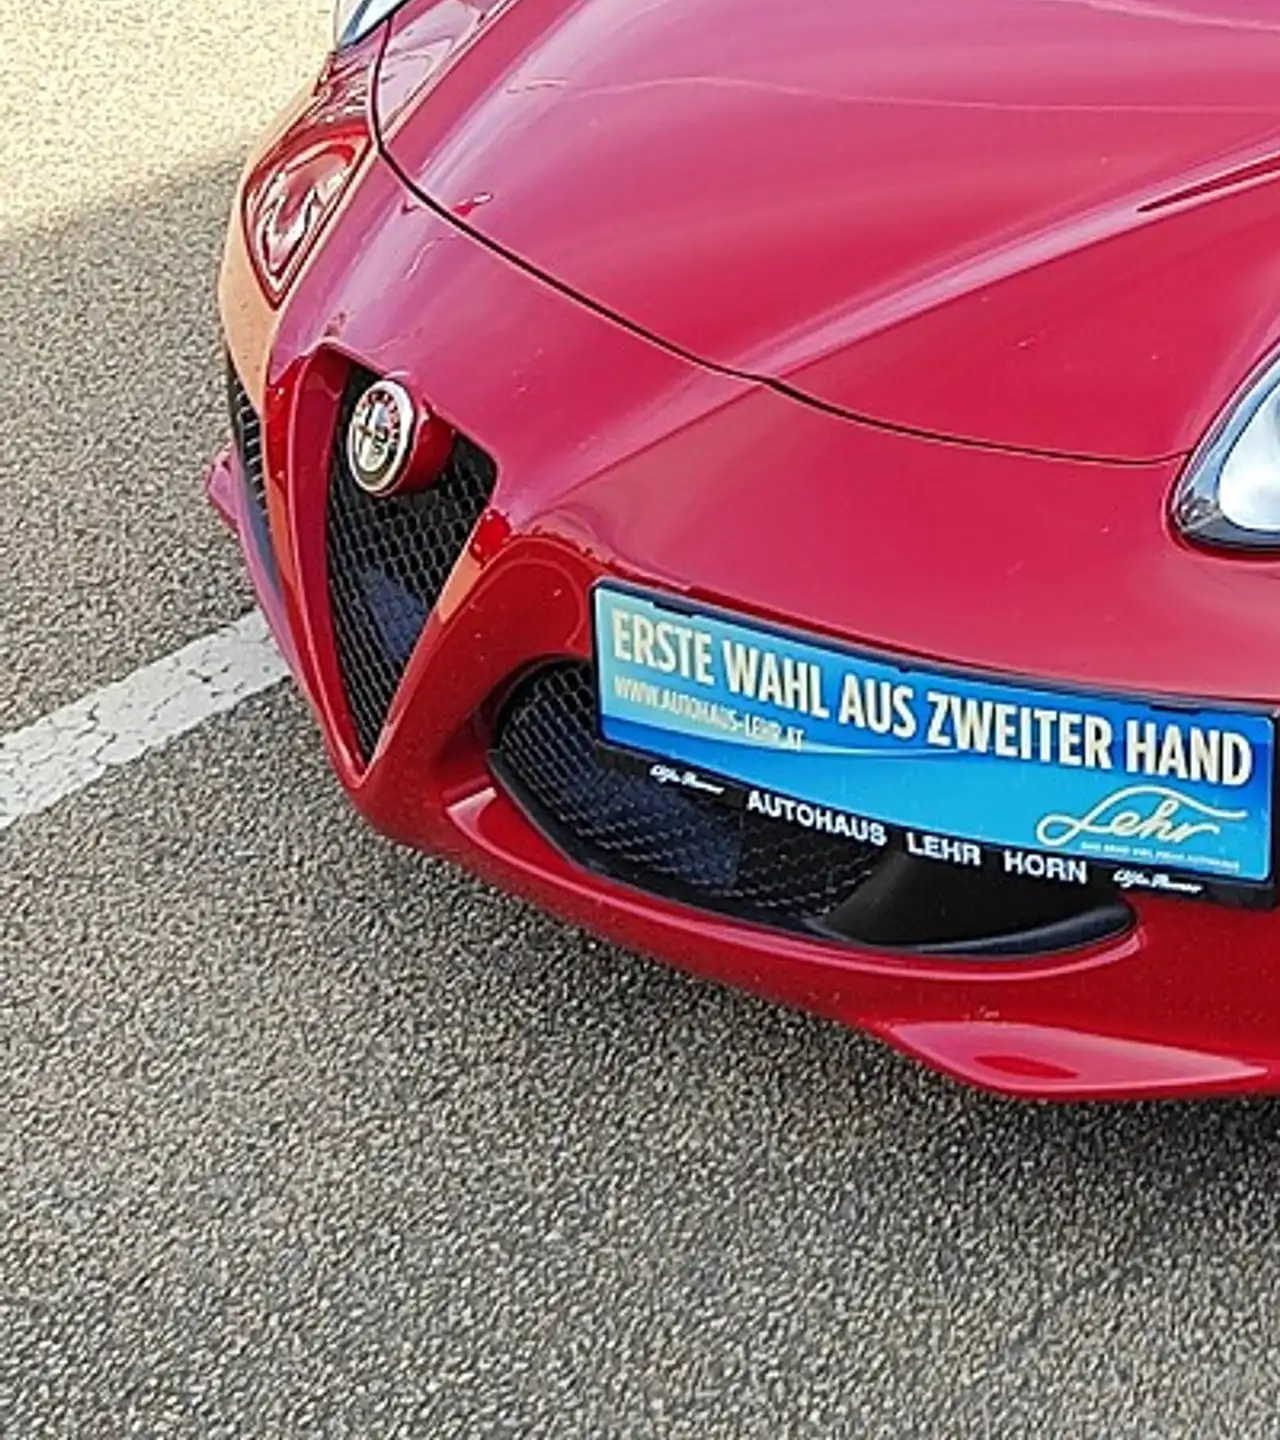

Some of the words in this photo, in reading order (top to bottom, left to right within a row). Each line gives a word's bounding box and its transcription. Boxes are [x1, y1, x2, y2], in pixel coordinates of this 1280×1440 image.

[612, 609, 715, 686] ERSTE
[722, 639, 830, 719] WAHL
[838, 673, 917, 738] AUS
[926, 690, 1113, 770] ZWEITER
[1126, 719, 1253, 786] HAND
[613, 675, 805, 752] WWW.AUTOHAUS-LEHR.AT
[746, 789, 889, 847] AUTOHAUS
[905, 831, 982, 867] LEHR
[1003, 849, 1089, 886] HORN
[1036, 784, 1248, 847] Lehr
